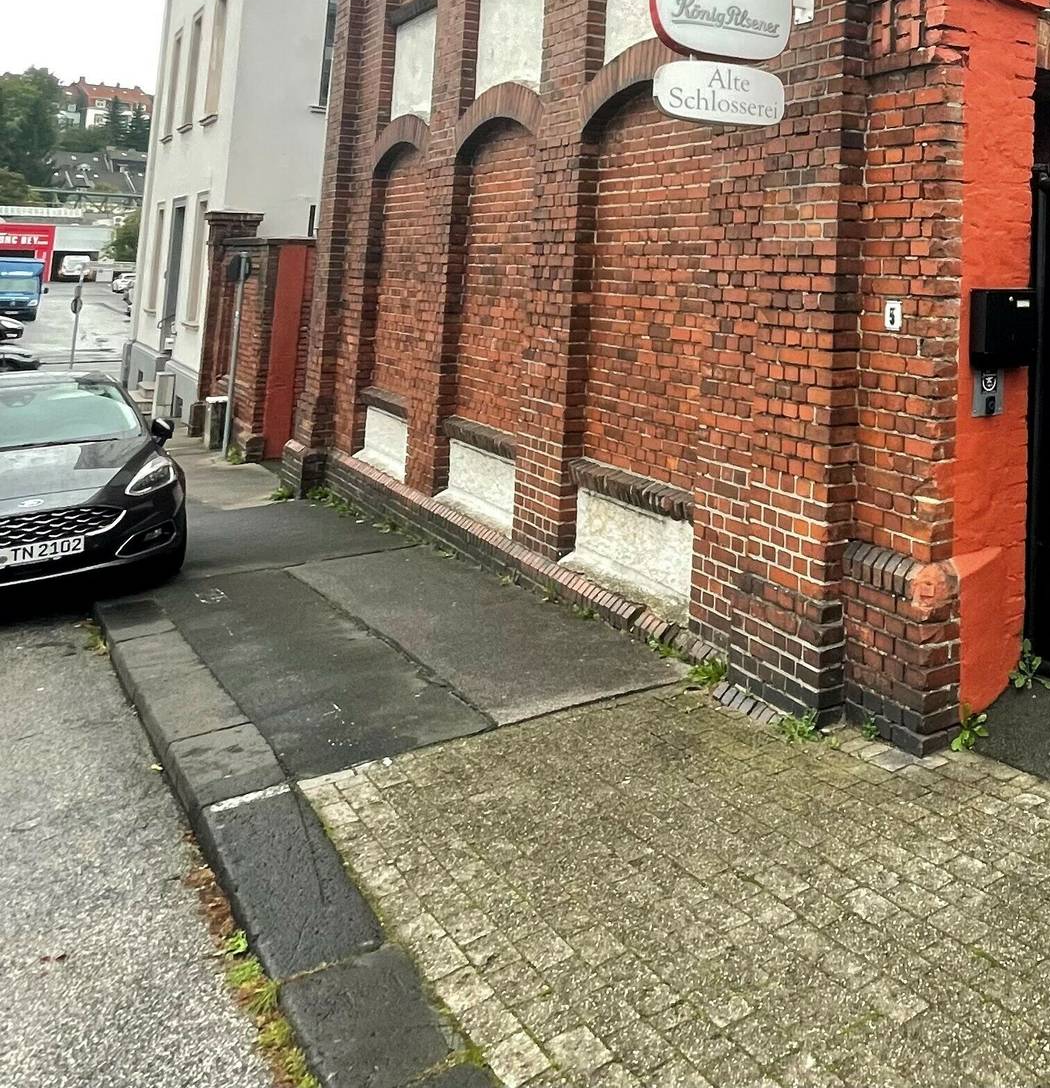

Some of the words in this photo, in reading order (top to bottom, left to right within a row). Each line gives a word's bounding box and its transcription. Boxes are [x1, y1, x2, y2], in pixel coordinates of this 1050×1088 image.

[725, 5, 780, 34] Pilsener
[708, 68, 750, 92] Alte
[669, 87, 778, 119] Schlosserei
[889, 307, 896, 326] 5
[11, 546, 34, 562] TN
[38, 539, 82, 557] 2102
